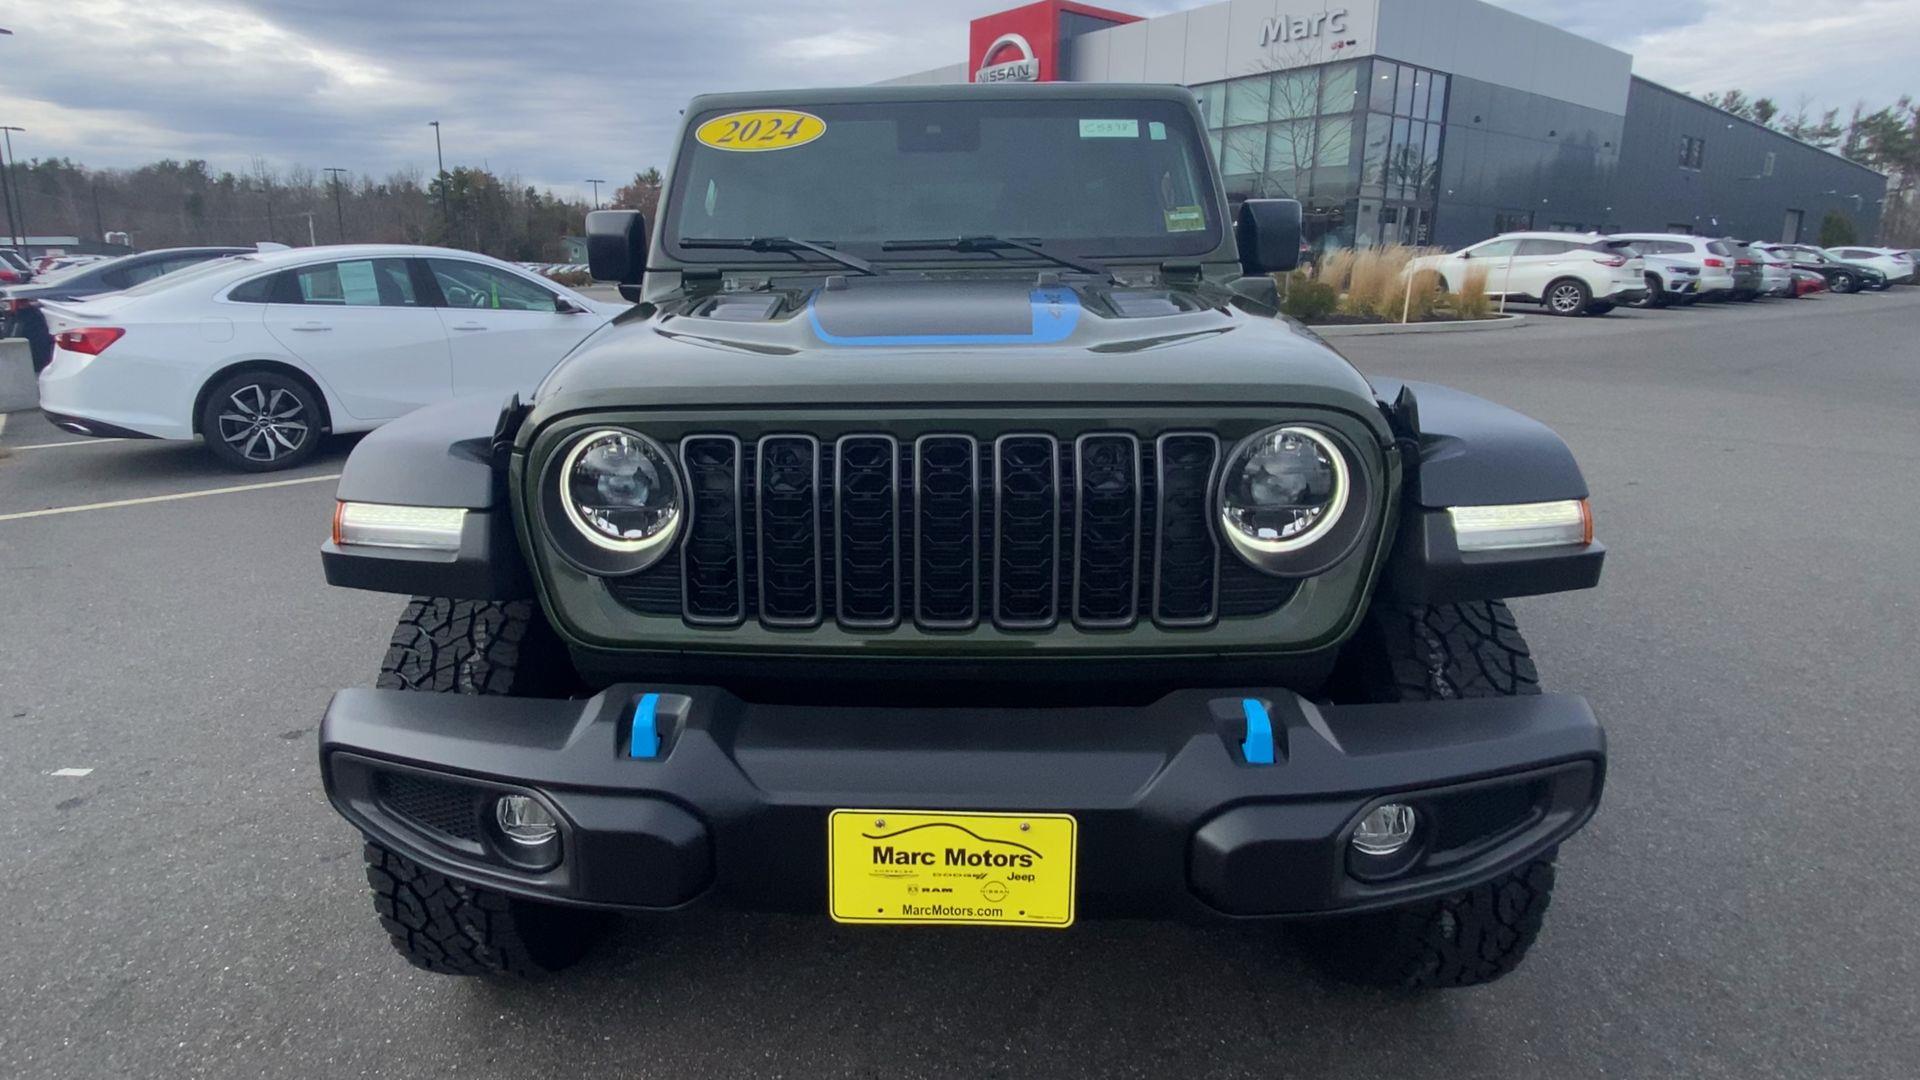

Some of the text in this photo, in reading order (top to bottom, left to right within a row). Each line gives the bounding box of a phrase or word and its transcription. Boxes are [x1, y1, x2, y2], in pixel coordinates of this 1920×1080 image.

[1260, 7, 1348, 46] Marc
[977, 63, 1030, 83] NISSAN
[715, 116, 805, 143] 2024
[872, 846, 1034, 868] Marc Motors
[1006, 871, 1036, 882] Jeep
[902, 904, 1004, 917] MarcMotors.com
